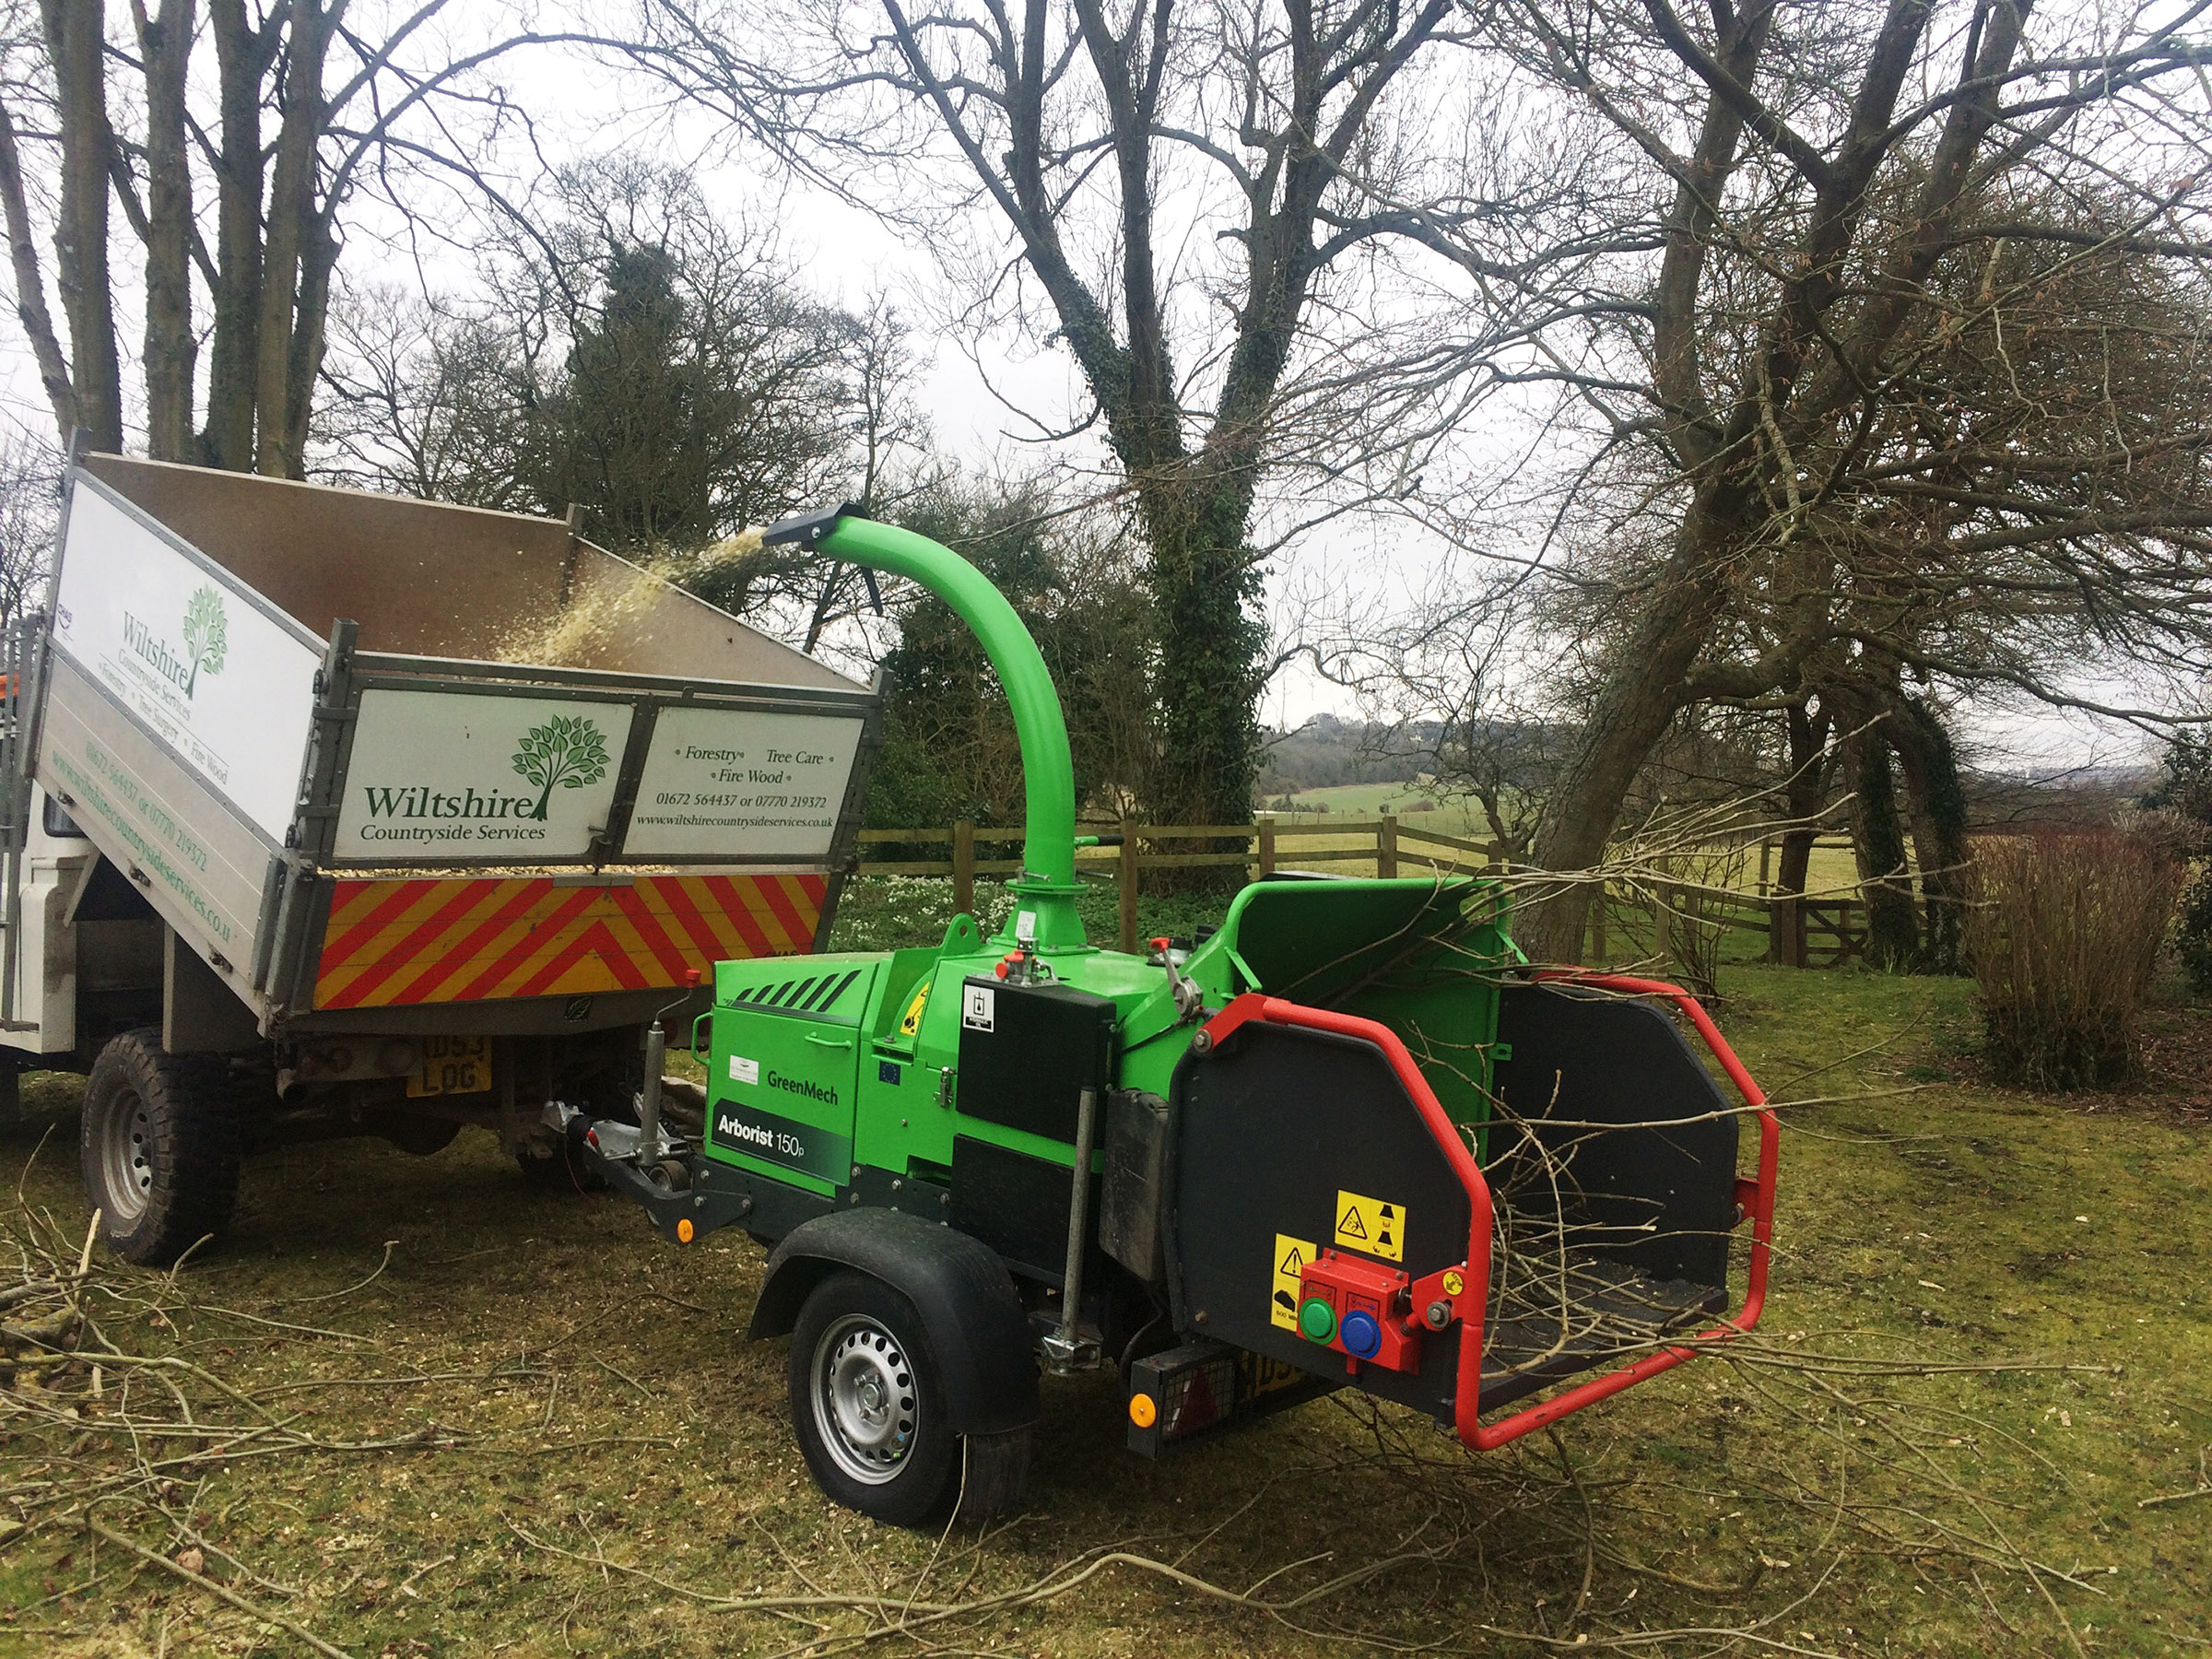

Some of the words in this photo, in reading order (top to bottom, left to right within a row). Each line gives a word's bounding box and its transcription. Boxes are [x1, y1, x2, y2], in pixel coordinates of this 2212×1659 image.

[124, 610, 189, 691] Wiltshire
[118, 649, 162, 695] Countryside
[161, 684, 192, 721] Services
[153, 708, 179, 743] Surgery
[191, 742, 206, 764] Fire
[207, 754, 229, 784] Wood
[685, 746, 739, 765] Forestry
[766, 749, 792, 764] Tree
[795, 751, 824, 765] Care
[718, 769, 744, 782] Fire
[747, 770, 784, 784] Wood
[364, 786, 534, 818] Wiltshire
[656, 792, 690, 806] 01672
[693, 793, 738, 806] 564437
[739, 795, 752, 807] or
[755, 794, 788, 808] 07770
[790, 795, 827, 808] 219372
[360, 824, 473, 845] Countryside
[477, 824, 547, 840] Services
[637, 814, 833, 830] www.wiltshirecountrysideservices.co.uk
[176, 830, 207, 872] 219372
[767, 1070, 839, 1106] GreenMech
[718, 1114, 773, 1147] Arborist
[776, 1133, 805, 1158] 150p
